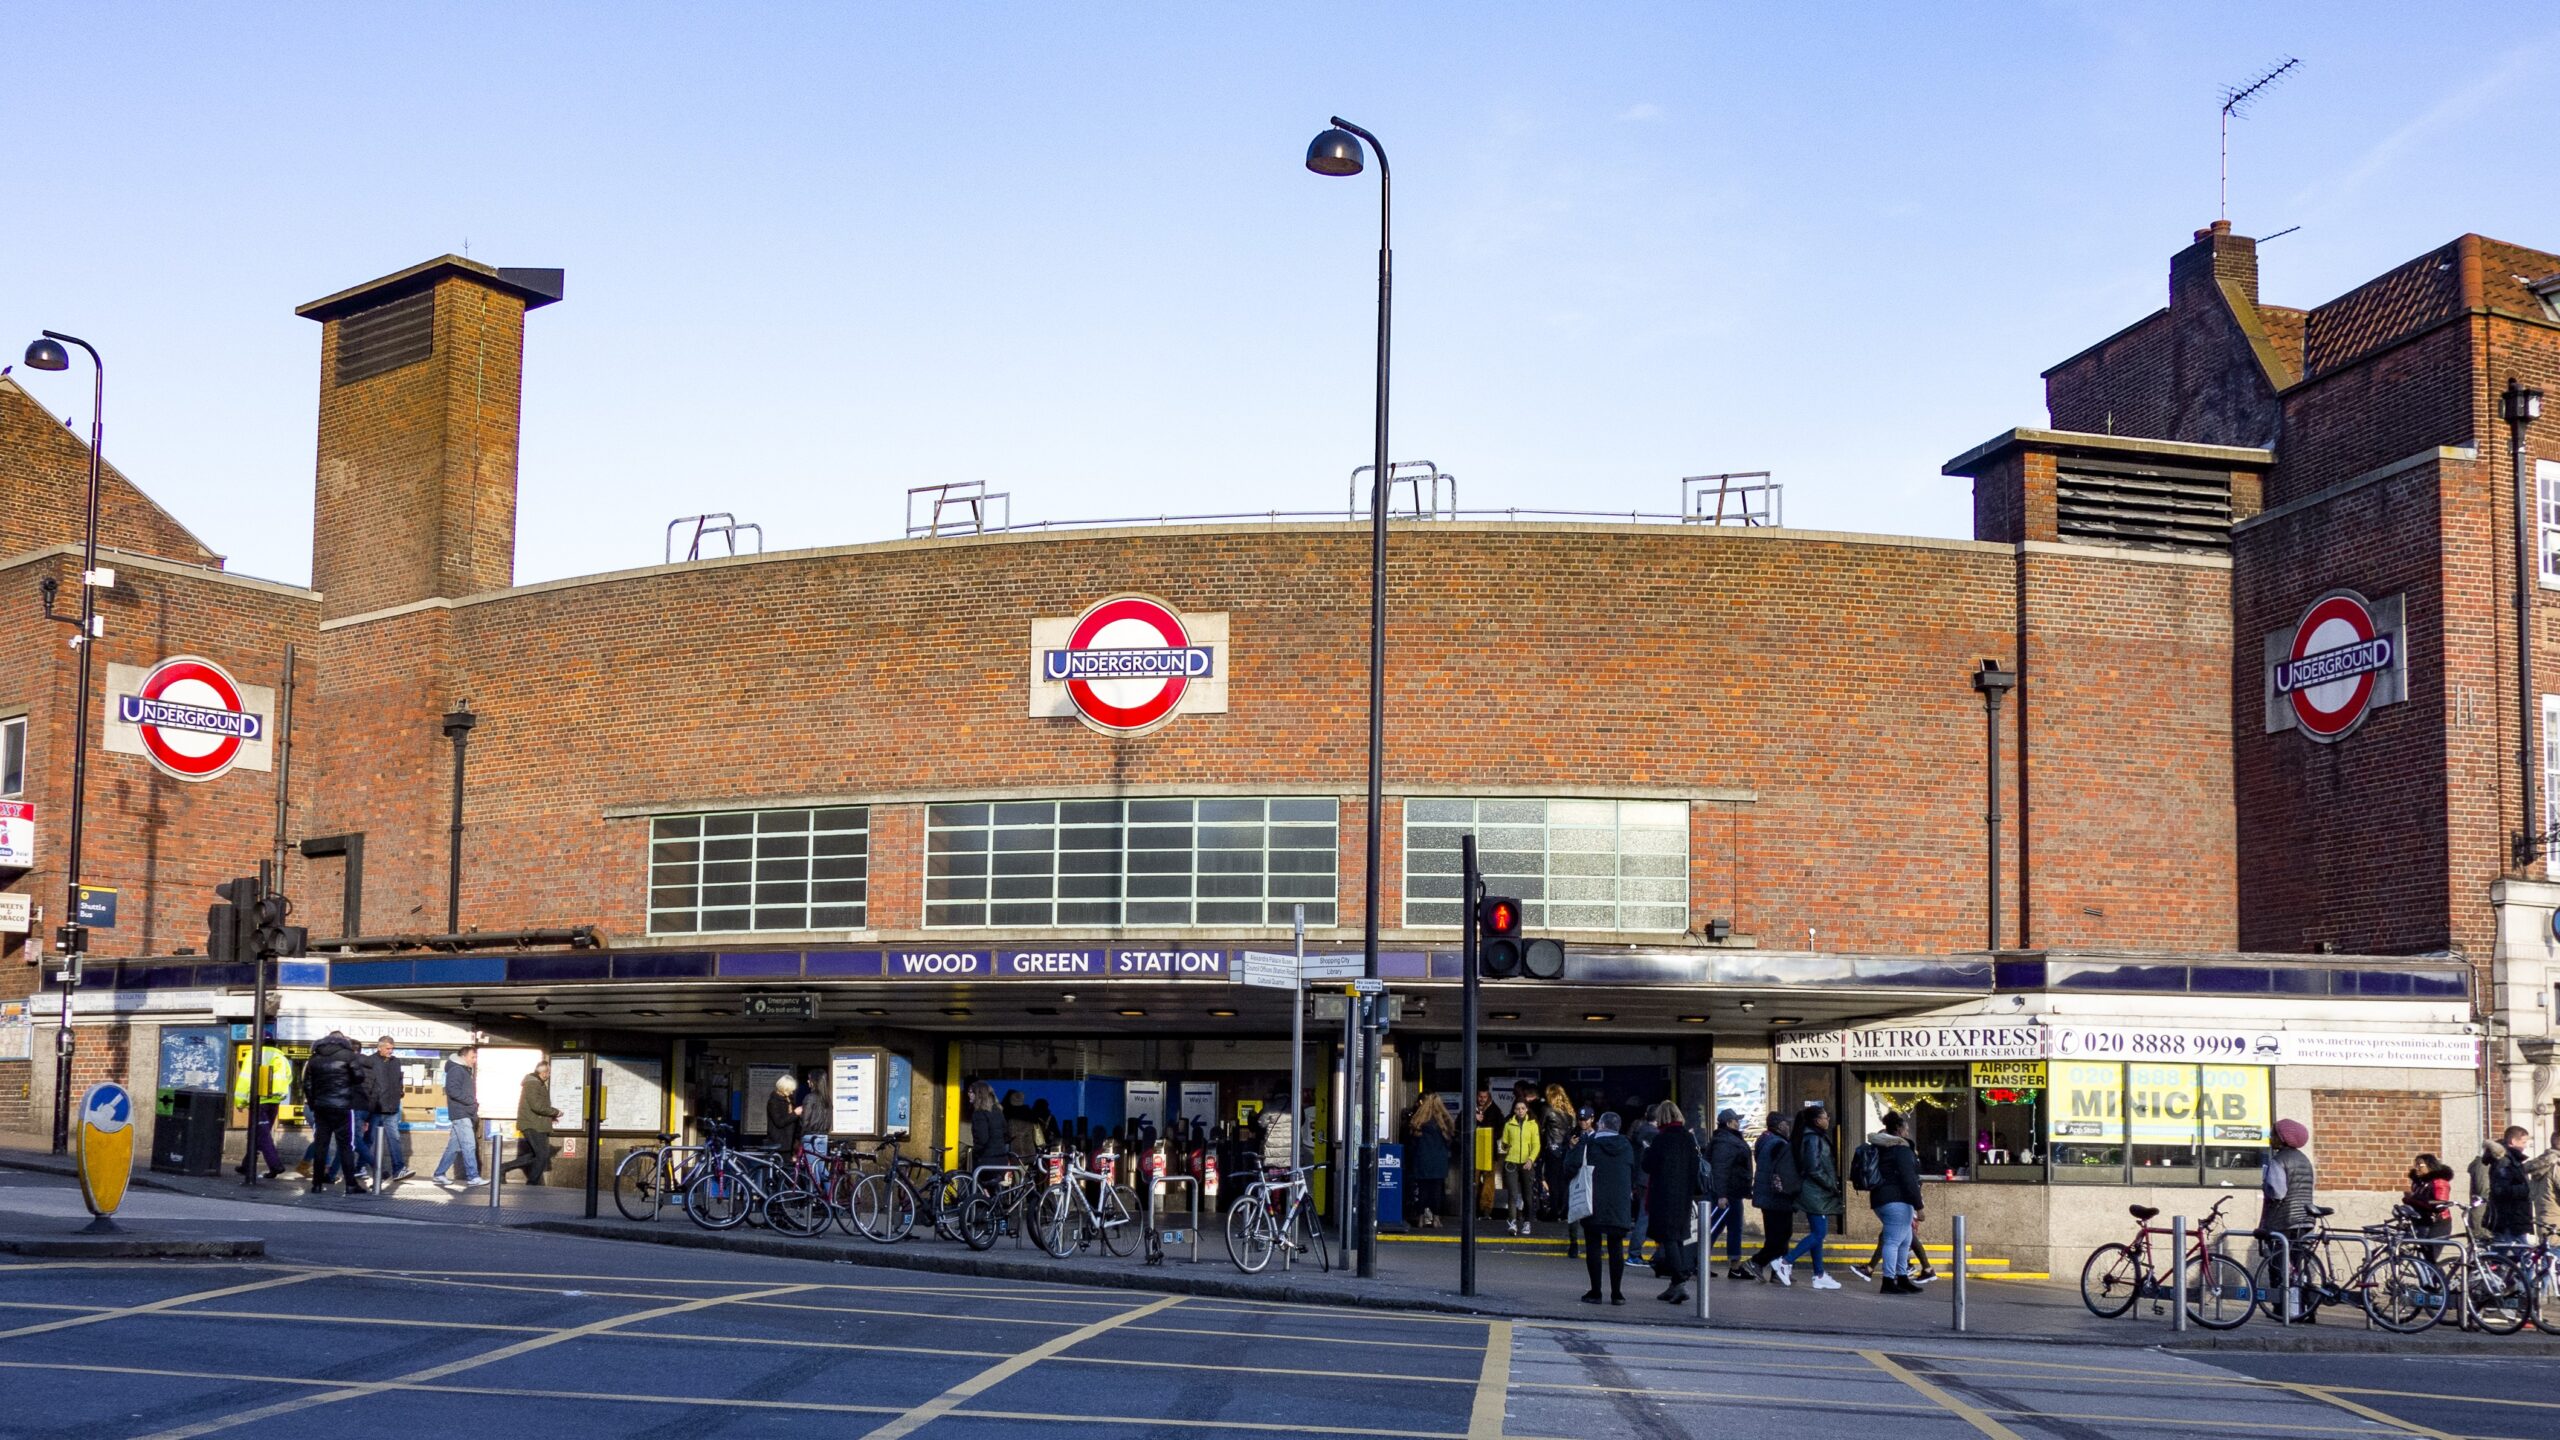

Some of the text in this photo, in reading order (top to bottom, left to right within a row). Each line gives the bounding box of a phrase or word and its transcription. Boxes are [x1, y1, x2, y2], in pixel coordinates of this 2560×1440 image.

[1048, 649, 1209, 679] UNDERGROUND
[2276, 638, 2391, 692] UNDERGROUND
[122, 697, 260, 738] UNDERGROUND
[80, 902, 107, 912] Shuttle
[80, 910, 94, 919] Bus
[902, 951, 1219, 973] WOOD GREEN STATION
[1319, 956, 1350, 966] Shopping City
[1246, 963, 1260, 972] Council
[1326, 967, 1343, 976] Library
[1257, 976, 1285, 986] Cultural Quarter
[767, 997, 800, 1006] Emergency
[348, 1025, 435, 1038] ENTERPRISE
[1780, 1032, 1840, 1044] EXPRESS
[1852, 1028, 2037, 1048] METRO EXPRESS
[2084, 1032, 2124, 1052] 020
[2132, 1033, 2185, 1054] 8888
[2298, 1037, 2470, 1050] www.metroexpressminicab.com
[1790, 1047, 1830, 1058] NEWS
[1852, 1050, 1862, 1058] 24
[1884, 1049, 1928, 1057] MINICAB
[1930, 1049, 1938, 1057] &
[1940, 1048, 1988, 1057] COURIER
[1991, 1047, 2035, 1056] SERVICE
[1980, 1063, 2039, 1073] AIRPORT
[1870, 1070, 1969, 1088] MINICA
[1973, 1075, 2045, 1086] TRANSFER
[2069, 1067, 2114, 1085] 020
[2130, 1068, 2181, 1087] 888
[1134, 1095, 1147, 1103] Way
[1189, 1096, 1202, 1104] Way
[1498, 1093, 1515, 1103] Way
[2071, 1089, 2247, 1121] MINICAB
[2068, 1126, 2100, 1136] App Store
[2226, 1130, 2247, 1140] Google
